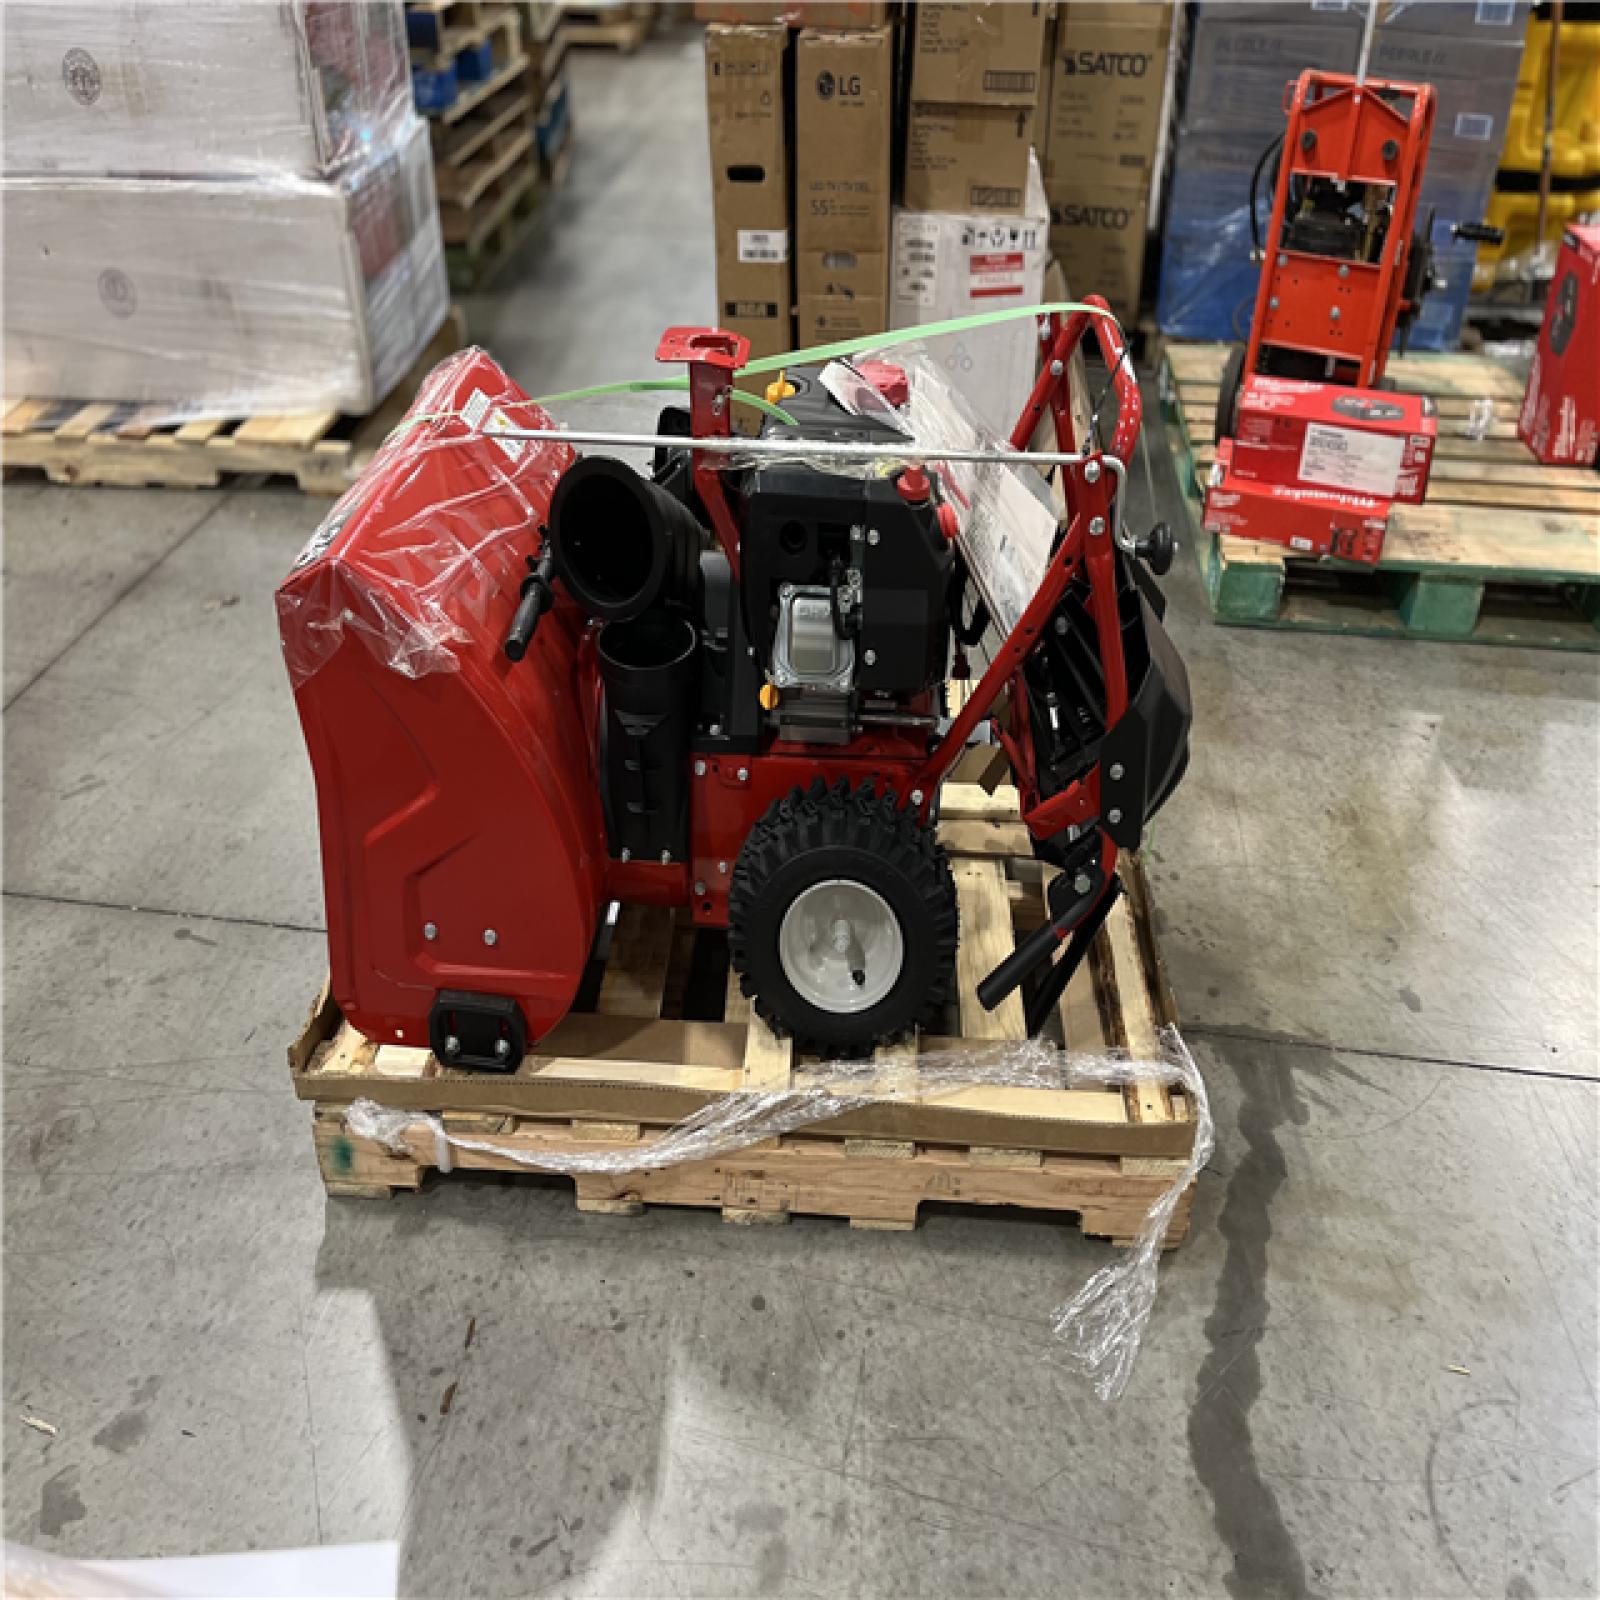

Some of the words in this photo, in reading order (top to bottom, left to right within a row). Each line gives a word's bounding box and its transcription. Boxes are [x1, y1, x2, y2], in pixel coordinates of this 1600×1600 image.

[1079, 52, 1146, 77] SATCO
[839, 74, 861, 95] LG
[1063, 204, 1128, 230] SATCO
